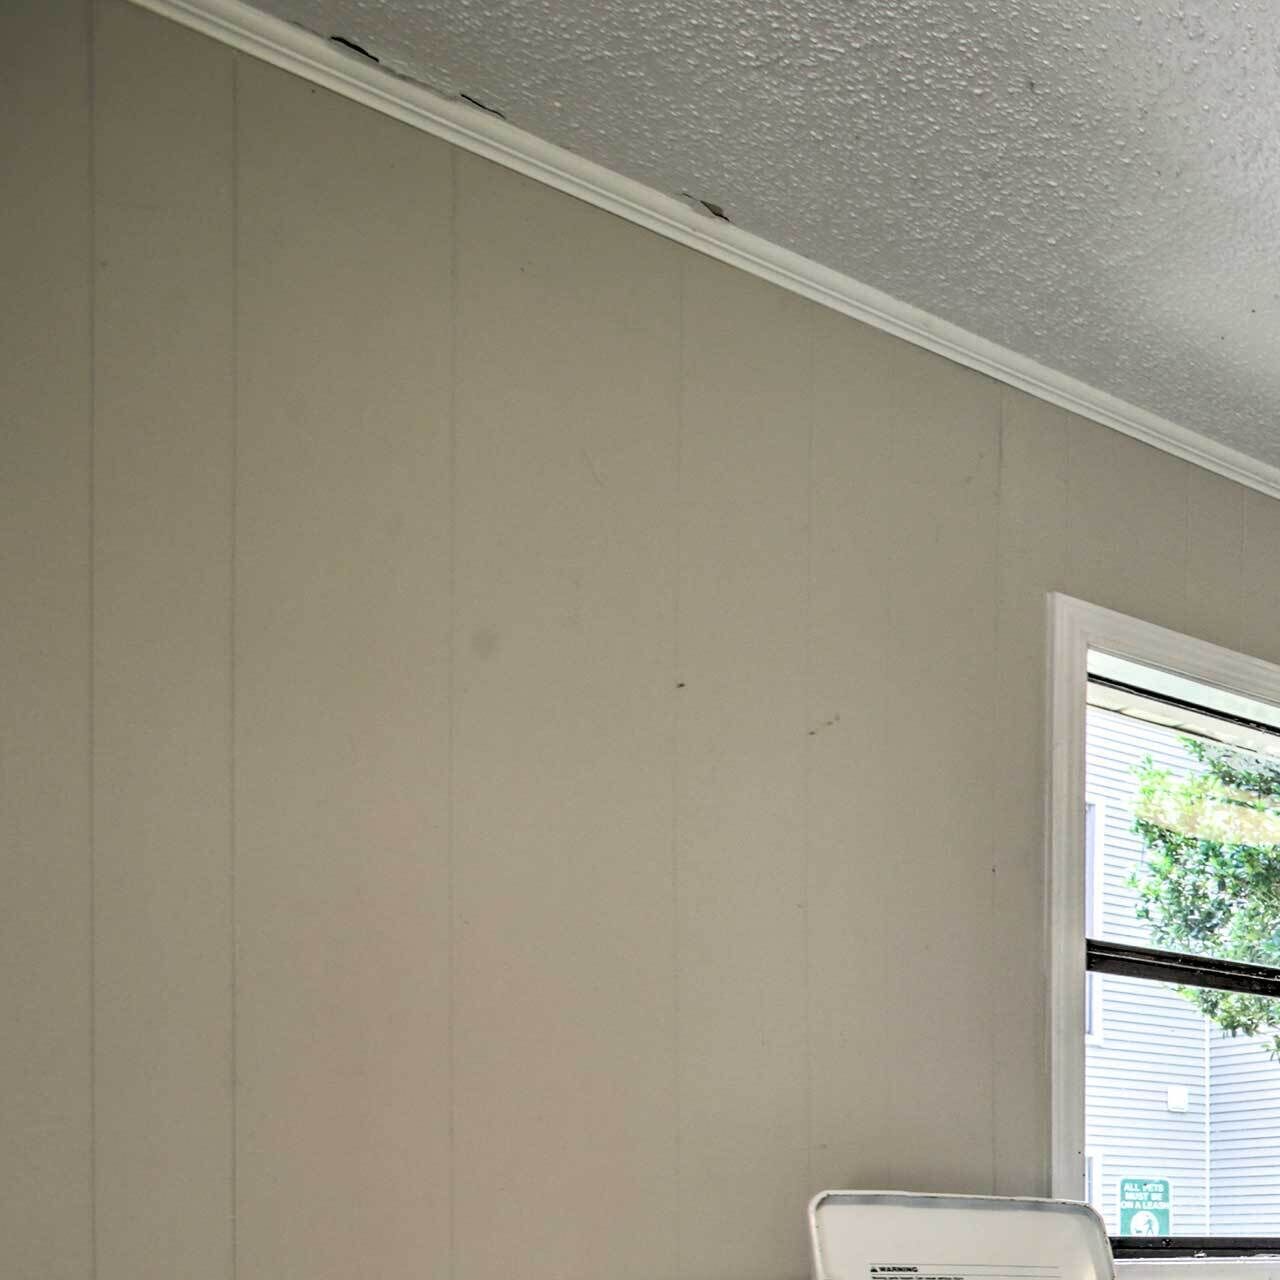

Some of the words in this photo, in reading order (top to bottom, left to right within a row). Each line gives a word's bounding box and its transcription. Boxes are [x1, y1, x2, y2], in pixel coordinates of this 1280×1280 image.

[1123, 1183, 1141, 1192] ALL
[1142, 1183, 1164, 1192] PETS
[1125, 1192, 1149, 1201] MUST
[1151, 1192, 1163, 1201] BE
[1120, 1200, 1134, 1209] ON
[1134, 1200, 1142, 1209] A
[1142, 1200, 1169, 1210] LEASH
